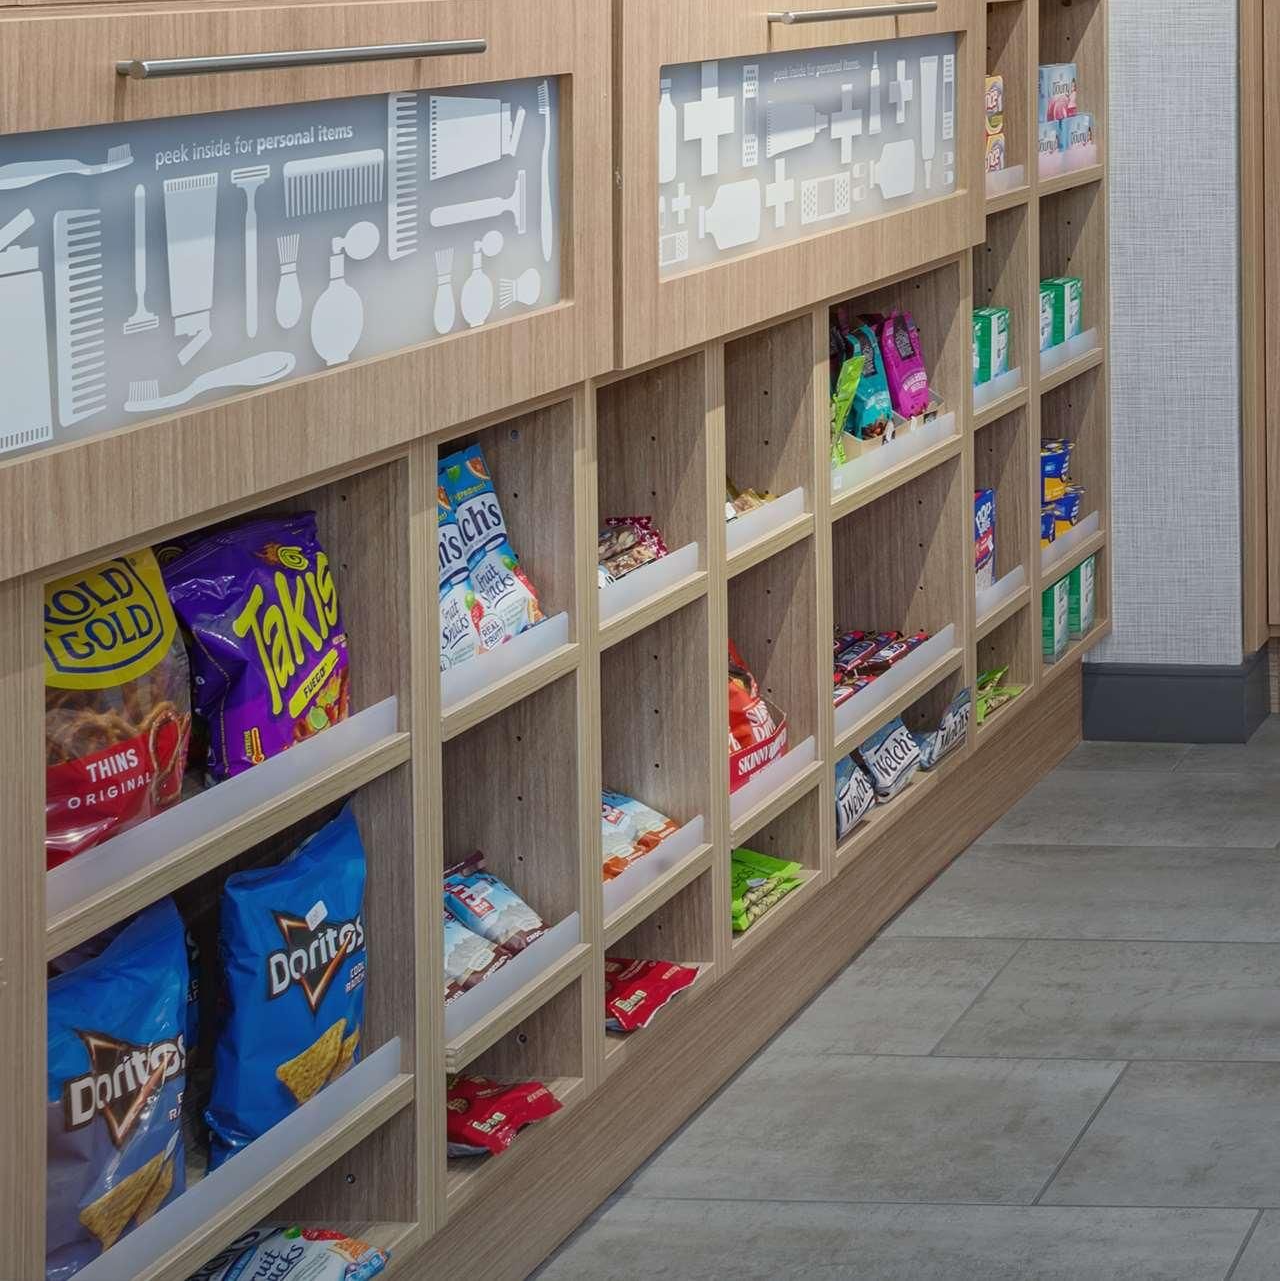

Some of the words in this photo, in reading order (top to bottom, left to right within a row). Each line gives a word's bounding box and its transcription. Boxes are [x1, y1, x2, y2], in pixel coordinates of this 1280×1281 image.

[155, 144, 189, 170] peek
[192, 138, 231, 161] inside
[234, 135, 254, 154] for
[256, 125, 315, 156] personal
[318, 124, 354, 143] items
[474, 564, 501, 594] Fruit
[480, 572, 516, 609] Snacks
[58, 604, 154, 660] GOLD
[232, 550, 339, 716] Takis
[480, 620, 502, 639] REAL
[302, 666, 328, 700] FUEGO
[86, 748, 139, 784] THINS
[873, 731, 918, 779] Welch's
[66, 773, 153, 811] ORIGINAL
[269, 917, 366, 998] Doritos
[69, 1033, 187, 1128] Doritos
